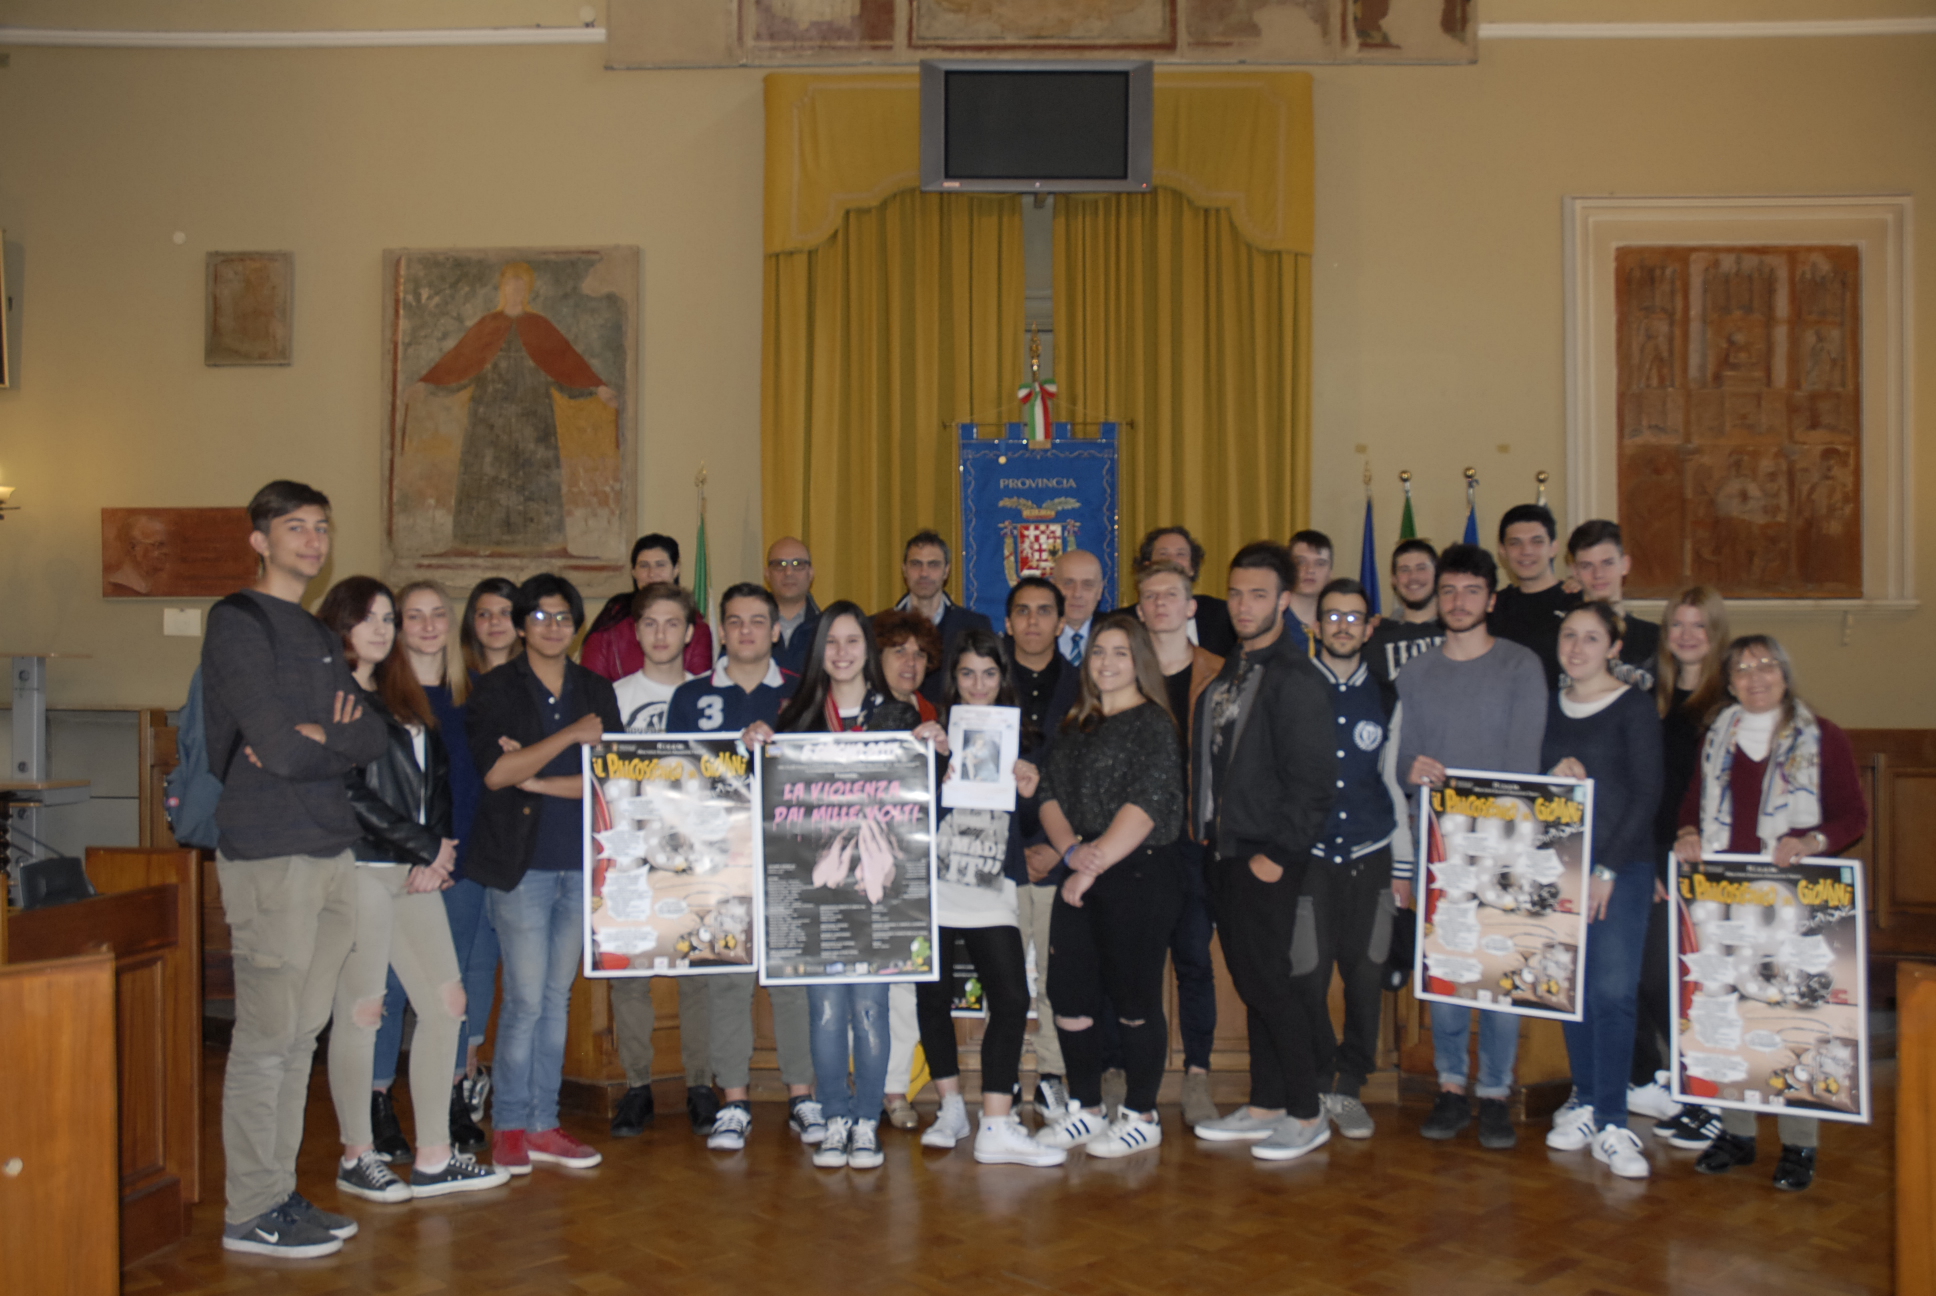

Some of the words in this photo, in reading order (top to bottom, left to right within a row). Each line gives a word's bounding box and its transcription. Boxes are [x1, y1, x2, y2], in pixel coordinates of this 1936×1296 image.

[999, 477, 1077, 489] PROVINCIA
[697, 694, 724, 731] 3
[784, 782, 806, 803] LA
[811, 780, 901, 803] VIOLENZA
[773, 805, 806, 828] DAI
[811, 805, 861, 827] MILLE
[865, 803, 921, 825] VOLTI
